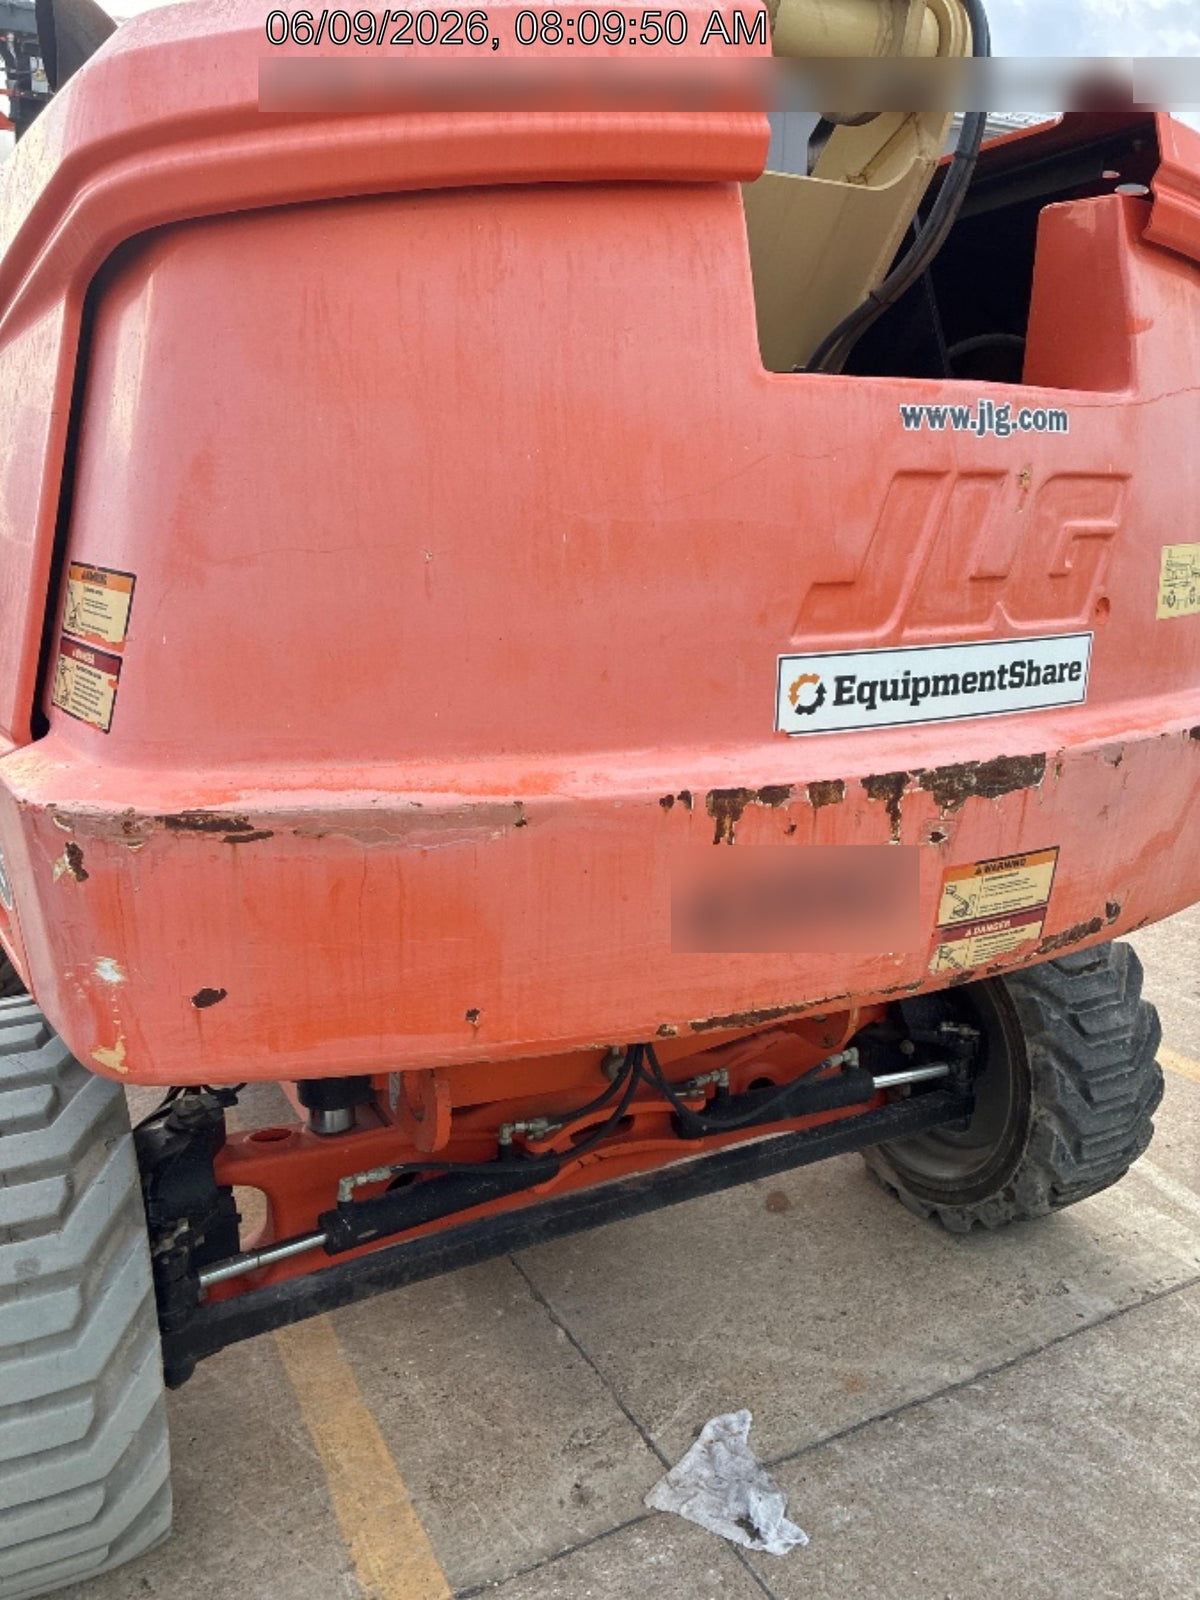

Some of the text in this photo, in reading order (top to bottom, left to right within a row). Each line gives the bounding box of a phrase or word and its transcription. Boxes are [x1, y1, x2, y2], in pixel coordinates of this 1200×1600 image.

[900, 401, 1069, 436] www.jlg.com
[790, 469, 1132, 646] JLG
[833, 660, 1082, 711] EquipmentShare
